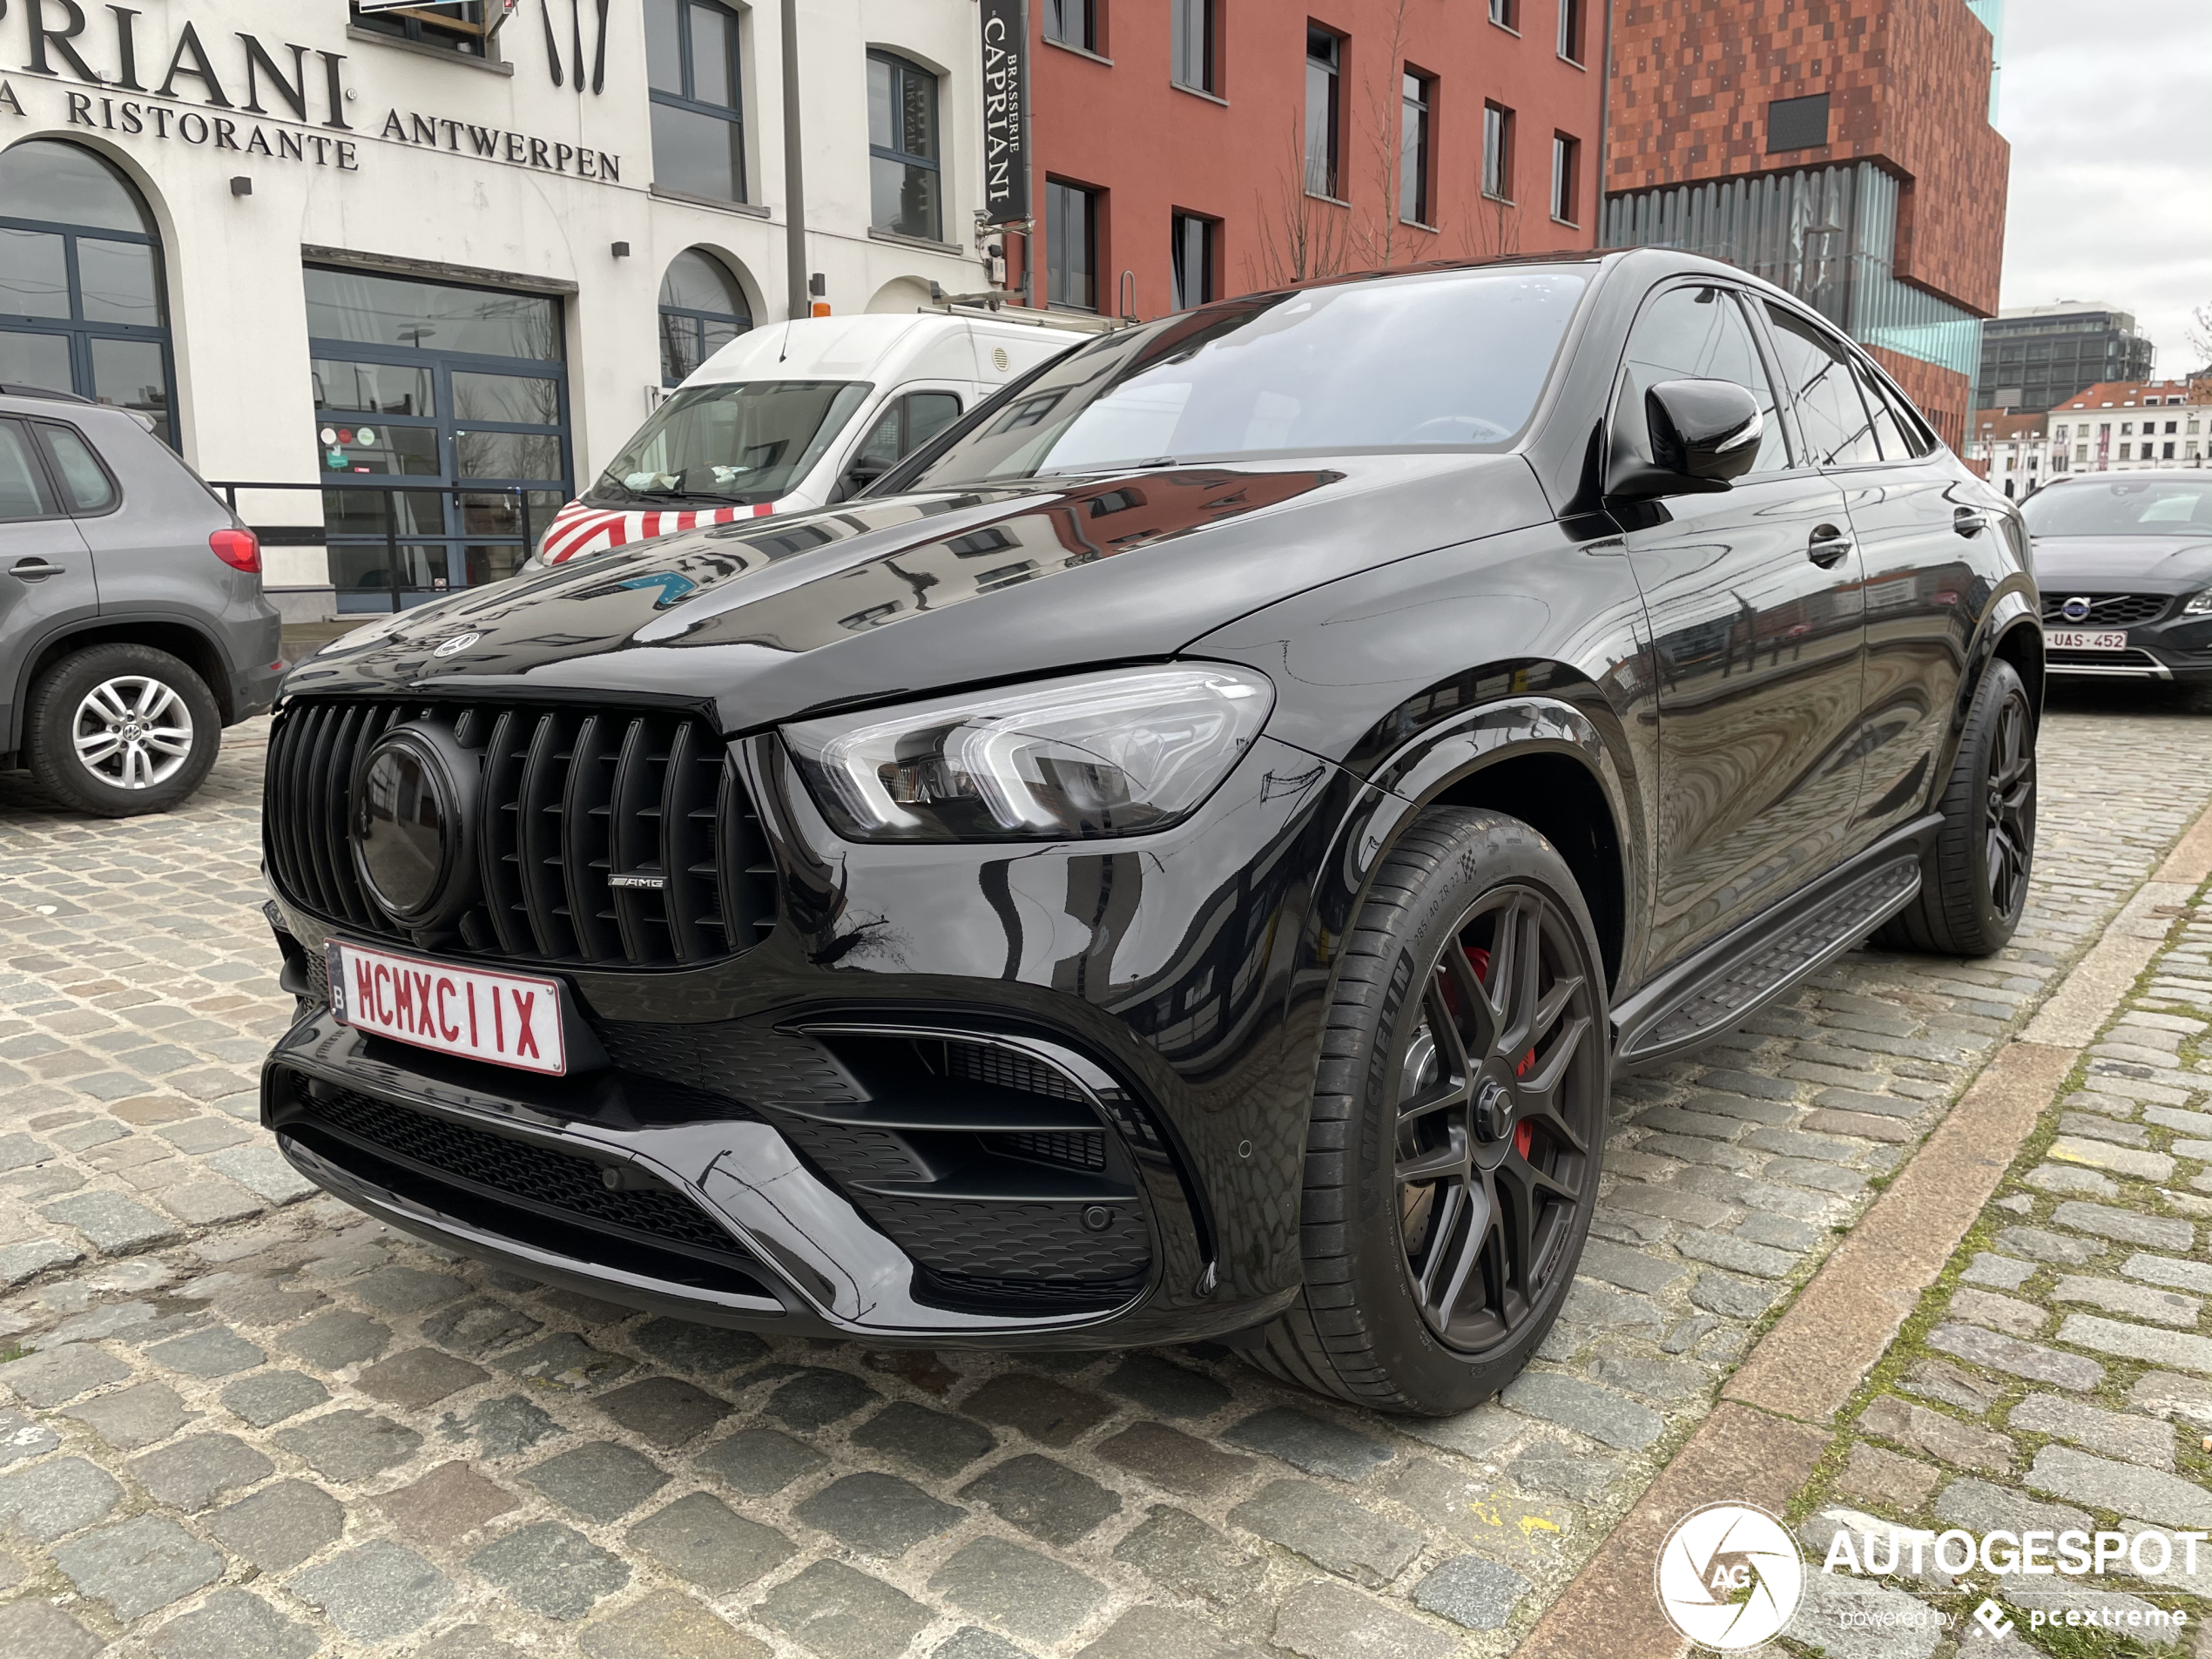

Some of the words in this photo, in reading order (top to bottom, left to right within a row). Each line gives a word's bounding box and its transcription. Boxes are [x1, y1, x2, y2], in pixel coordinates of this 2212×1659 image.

[0, 0, 353, 130] RIANI
[984, 17, 1009, 202] CAPRIANI
[1007, 53, 1020, 153] BRASSERIE
[65, 91, 359, 171] RISTORANTE
[381, 108, 621, 183] ANTWERPEN
[625, 878, 664, 888] AMG
[1438, 883, 1451, 902] ZR
[1450, 872, 1460, 887] 22
[333, 985, 345, 1010] B
[355, 957, 540, 1060] MCMXCIIX
[1361, 958, 1411, 1163] MICHELIN
